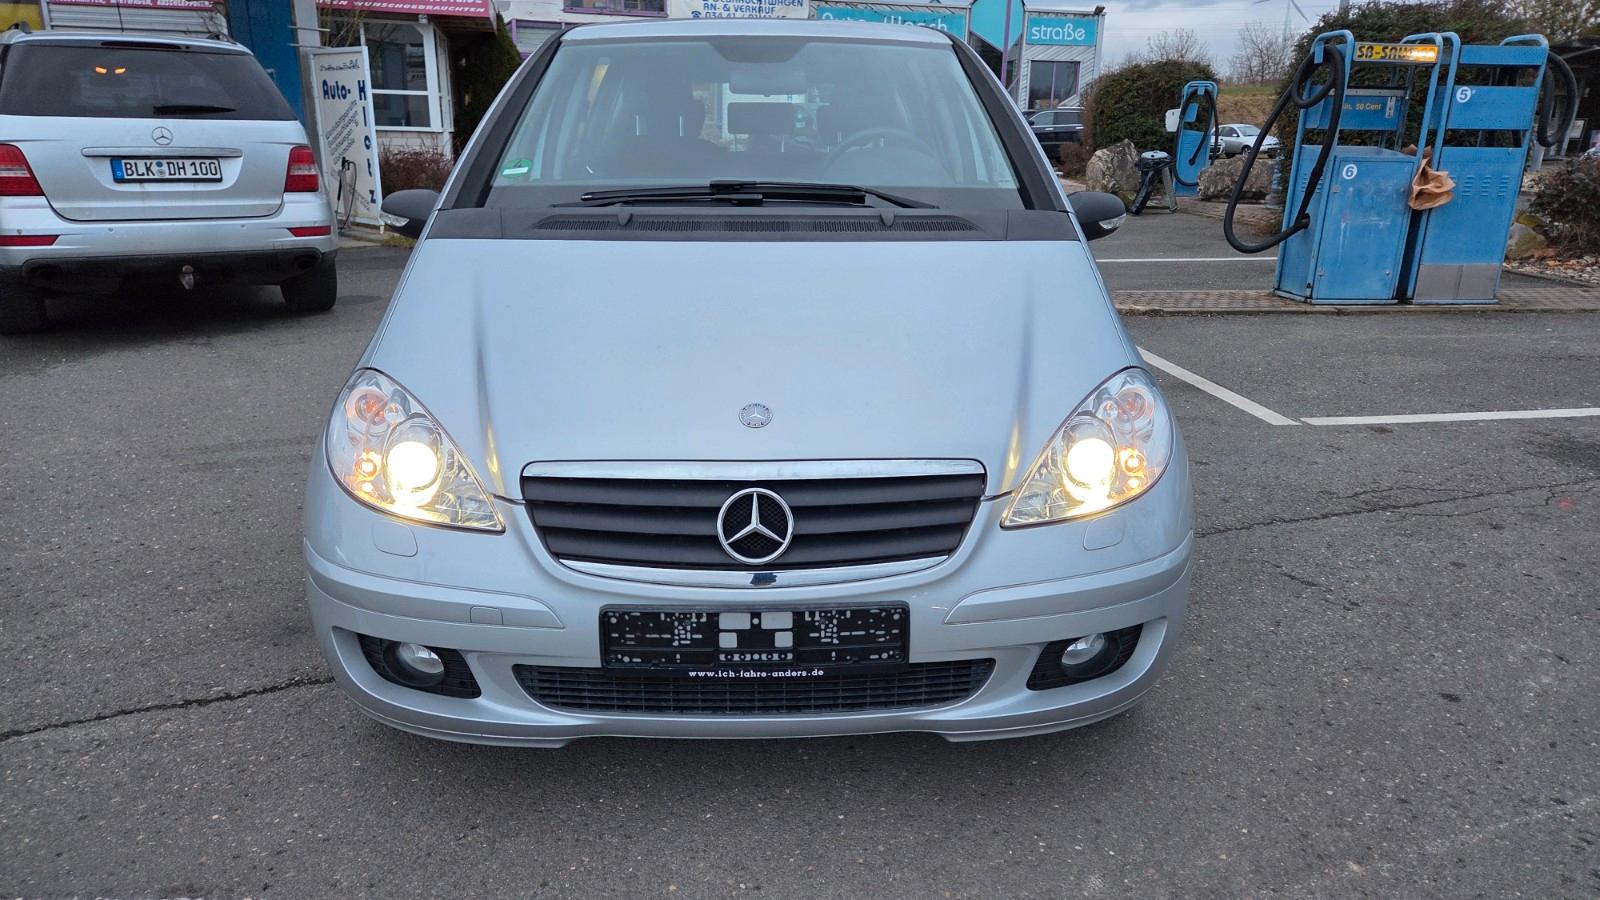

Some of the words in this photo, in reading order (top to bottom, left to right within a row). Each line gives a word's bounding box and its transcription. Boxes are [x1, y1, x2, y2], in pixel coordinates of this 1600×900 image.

[733, 5, 776, 14] VERKAUF
[1031, 23, 1086, 40] straße
[1357, 45, 1437, 58] SB-SAU
[322, 79, 351, 100] Auto-
[1459, 88, 1469, 100] 5
[124, 161, 156, 177] BLK
[166, 161, 187, 177] DH
[190, 161, 218, 176] 100
[1345, 165, 1356, 178] 6
